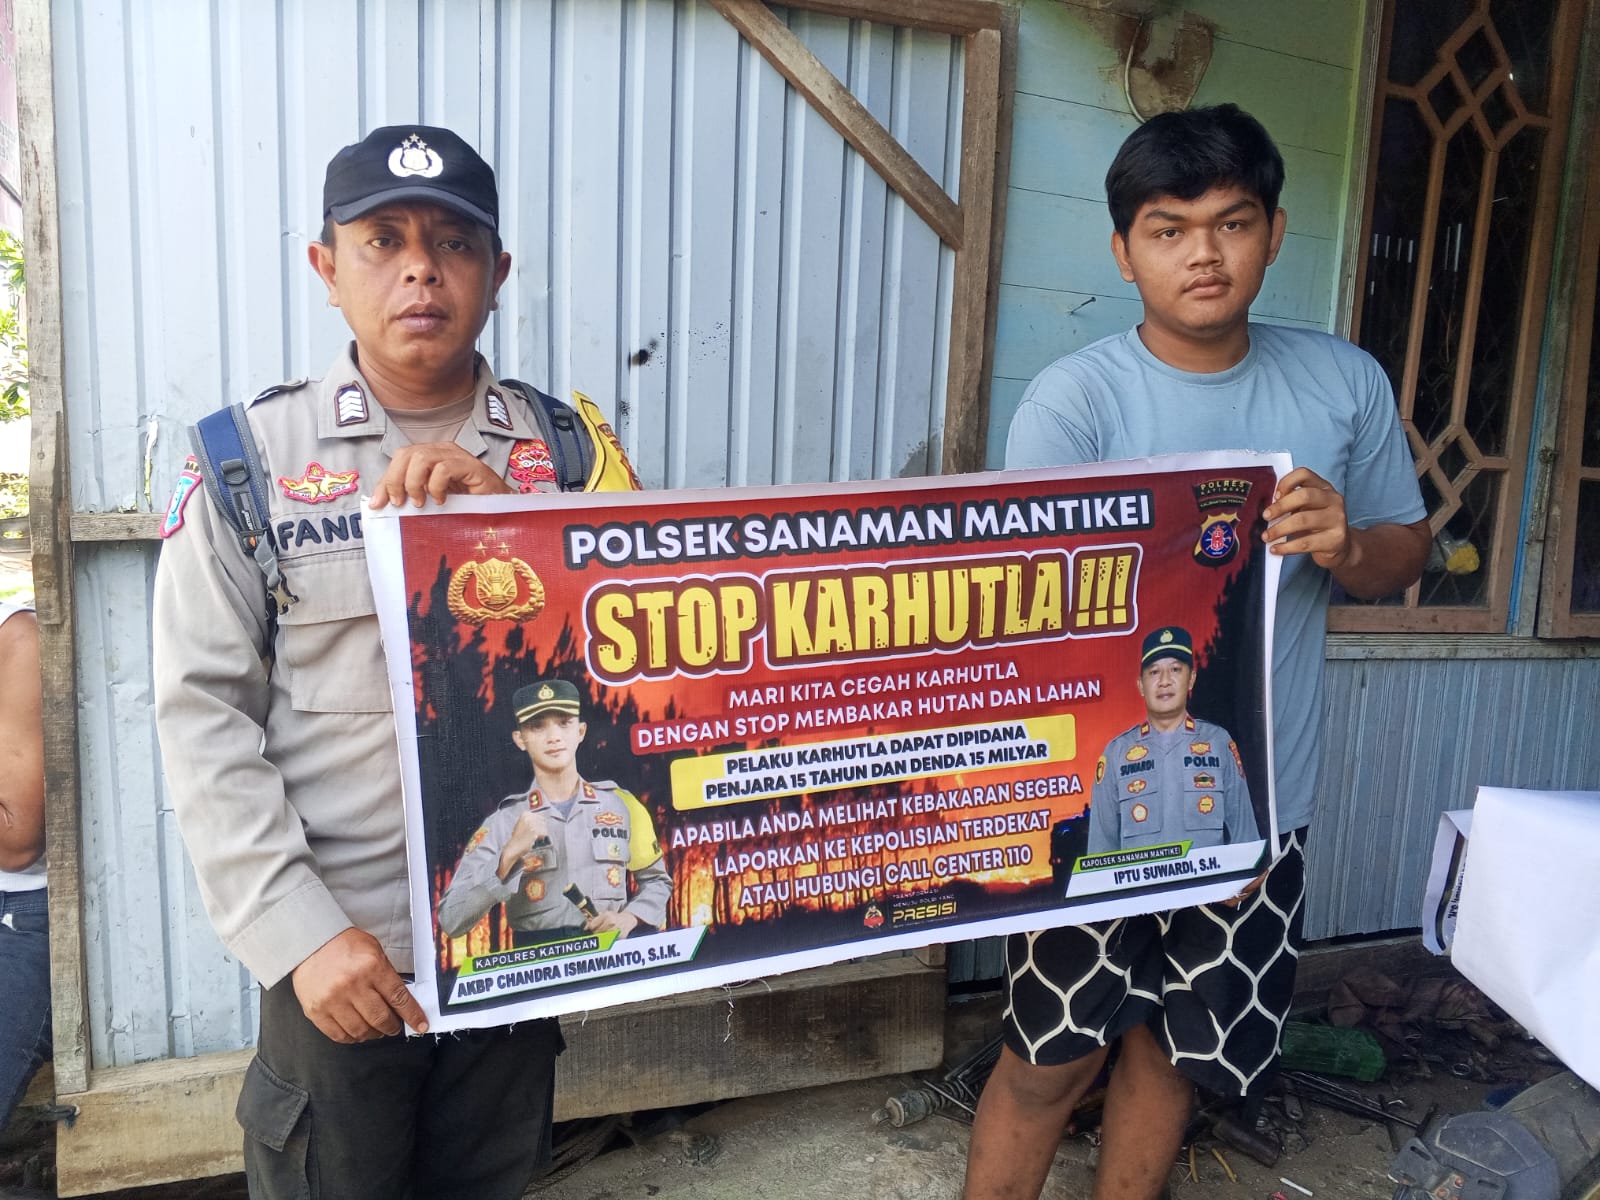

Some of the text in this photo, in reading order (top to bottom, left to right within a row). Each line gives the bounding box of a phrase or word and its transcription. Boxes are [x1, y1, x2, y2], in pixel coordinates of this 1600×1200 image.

[570, 494, 1151, 564] POLSEK SANAMAN MANTIKEI
[594, 585, 758, 674] STOP
[772, 560, 1063, 658] KARHUTLA
[728, 661, 1019, 709] MARI KITA CEGAH KARHUTLA
[637, 679, 1101, 748] DENGAN STOP MEMBAKAR HUTAN DAN LAHAN
[705, 743, 1047, 801] PENJARA 15 TAHUN DAN DENDA 15 MILYAR
[726, 725, 1026, 775] PELAKU KARHUTLA DAPAT DIPIDANA
[1183, 756, 1220, 768] POLRI
[592, 828, 628, 839] POLRI
[672, 775, 1083, 849] APABILA ANDA MELIHAT KEBAKARAN SEGERA
[713, 810, 1051, 878] LAPORKAN KE KEPOLISIAN TERDEKAT
[1081, 846, 1181, 868] KAPOLSEK SANAMAN MANTIKEI
[739, 845, 1032, 908] ATAU HUBUNGI CALL CENTER 110
[1113, 856, 1221, 885] IPTU SUWARDI, S.H.
[892, 901, 957, 923] PRESISI
[457, 943, 681, 998] AKBP CHANDRA ISMAWANTO, S.I.K.
[475, 939, 598, 969] KAPOLRES KATINGAN
